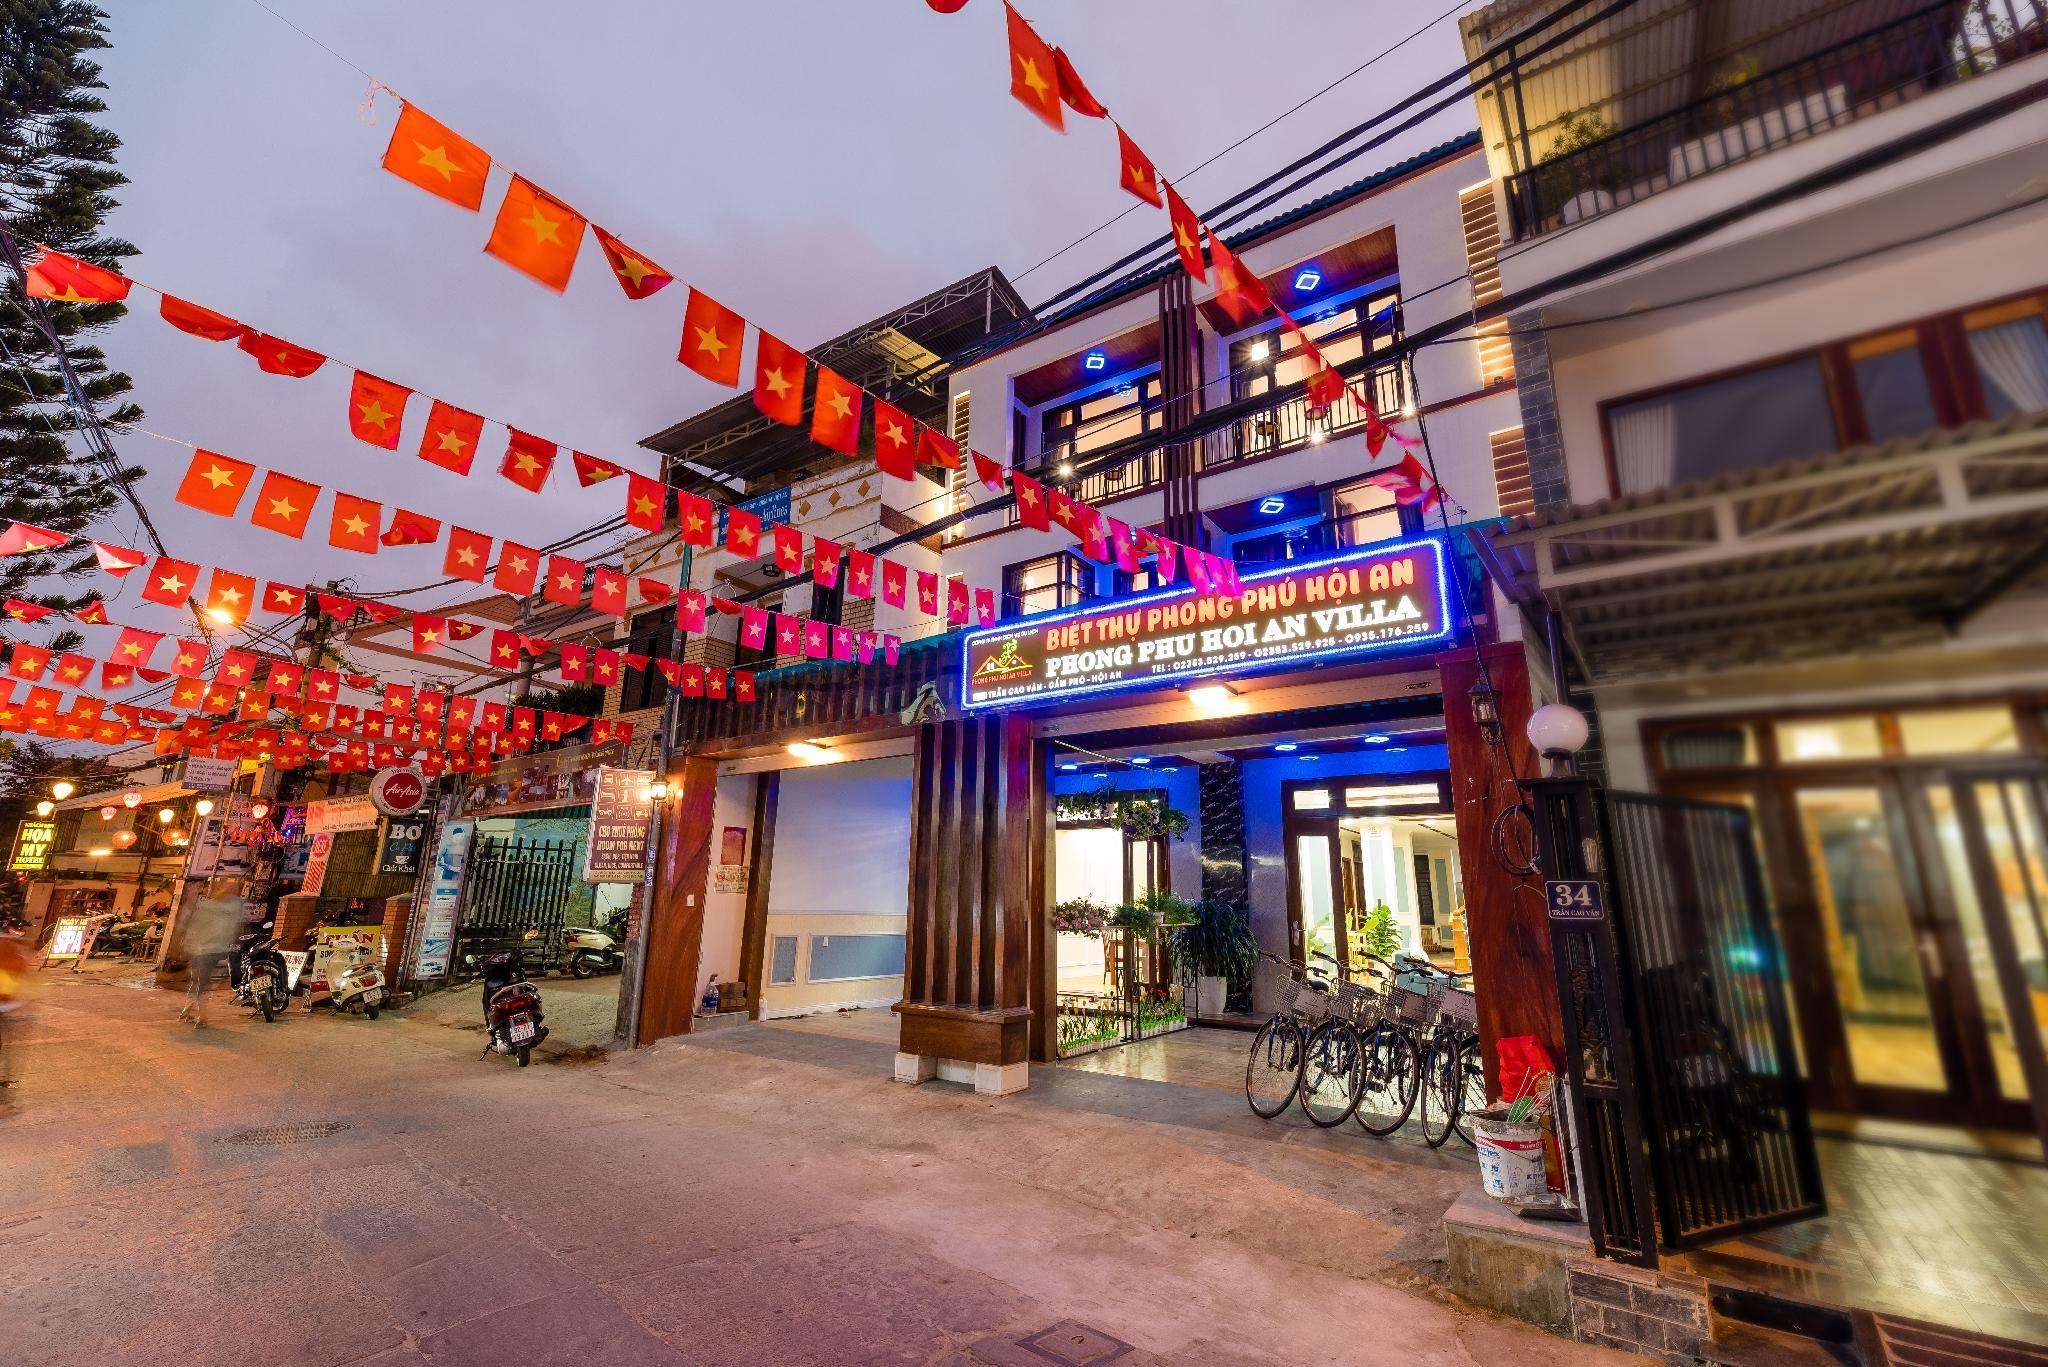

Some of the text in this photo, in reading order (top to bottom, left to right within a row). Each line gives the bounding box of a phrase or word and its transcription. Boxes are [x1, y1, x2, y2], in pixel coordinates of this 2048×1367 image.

[1046, 558, 1414, 653] BIỆT THỰ PHONG PHÚ HỘI AN
[1045, 595, 1421, 678] PHONG PHU HOI AN VILLA
[1110, 670, 1122, 679] AN
[1151, 662, 1166, 675] TEL
[386, 783, 420, 797] AirAsia
[616, 841, 628, 850] FOR
[1556, 885, 1592, 905] 34
[1552, 907, 1570, 916] TRẦN
[53, 930, 84, 954] SPA
